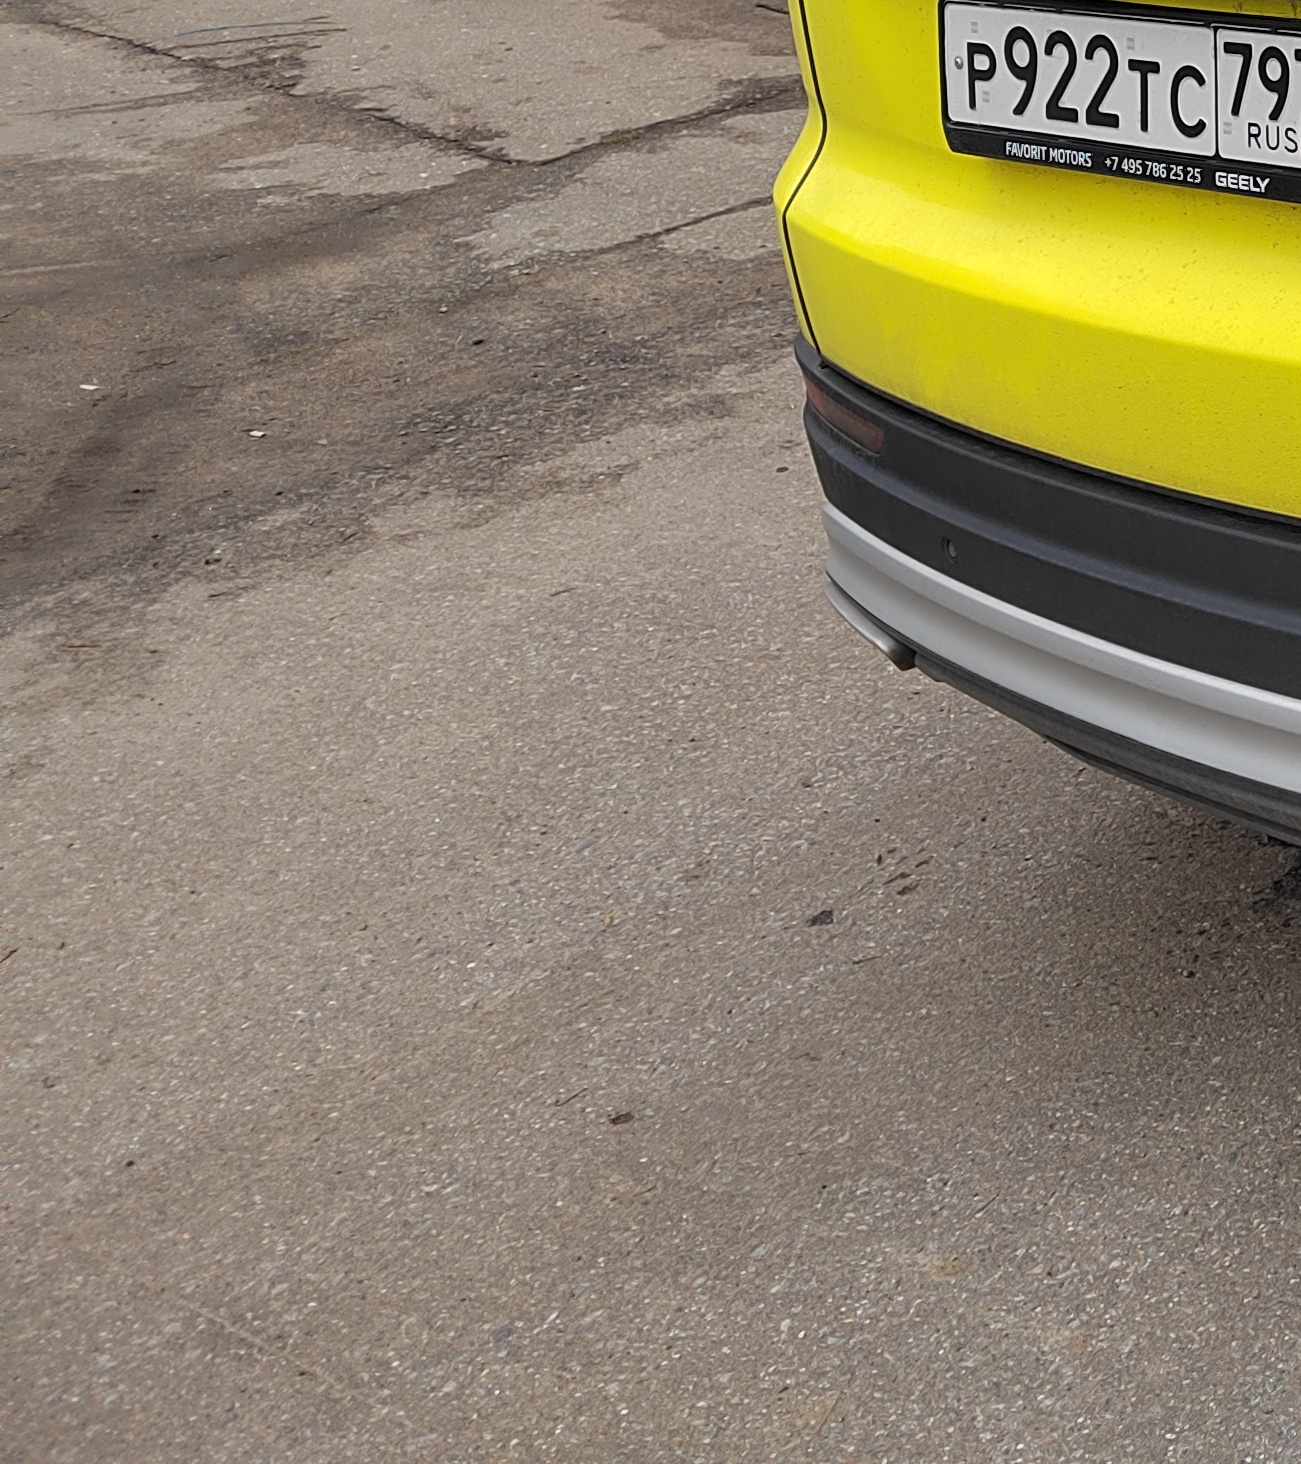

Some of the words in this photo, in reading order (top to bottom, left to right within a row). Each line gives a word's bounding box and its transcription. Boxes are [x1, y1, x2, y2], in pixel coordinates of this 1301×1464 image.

[1247, 122, 1298, 154] RUS
[1005, 141, 1047, 161] FAVORIT
[1050, 147, 1093, 168] MOTORS
[1104, 156, 1119, 171] +7
[1121, 158, 1143, 175] 495
[1145, 161, 1167, 179] 786
[1169, 164, 1184, 181] 25
[1186, 167, 1202, 184] 25
[1215, 171, 1270, 193] GEELY
